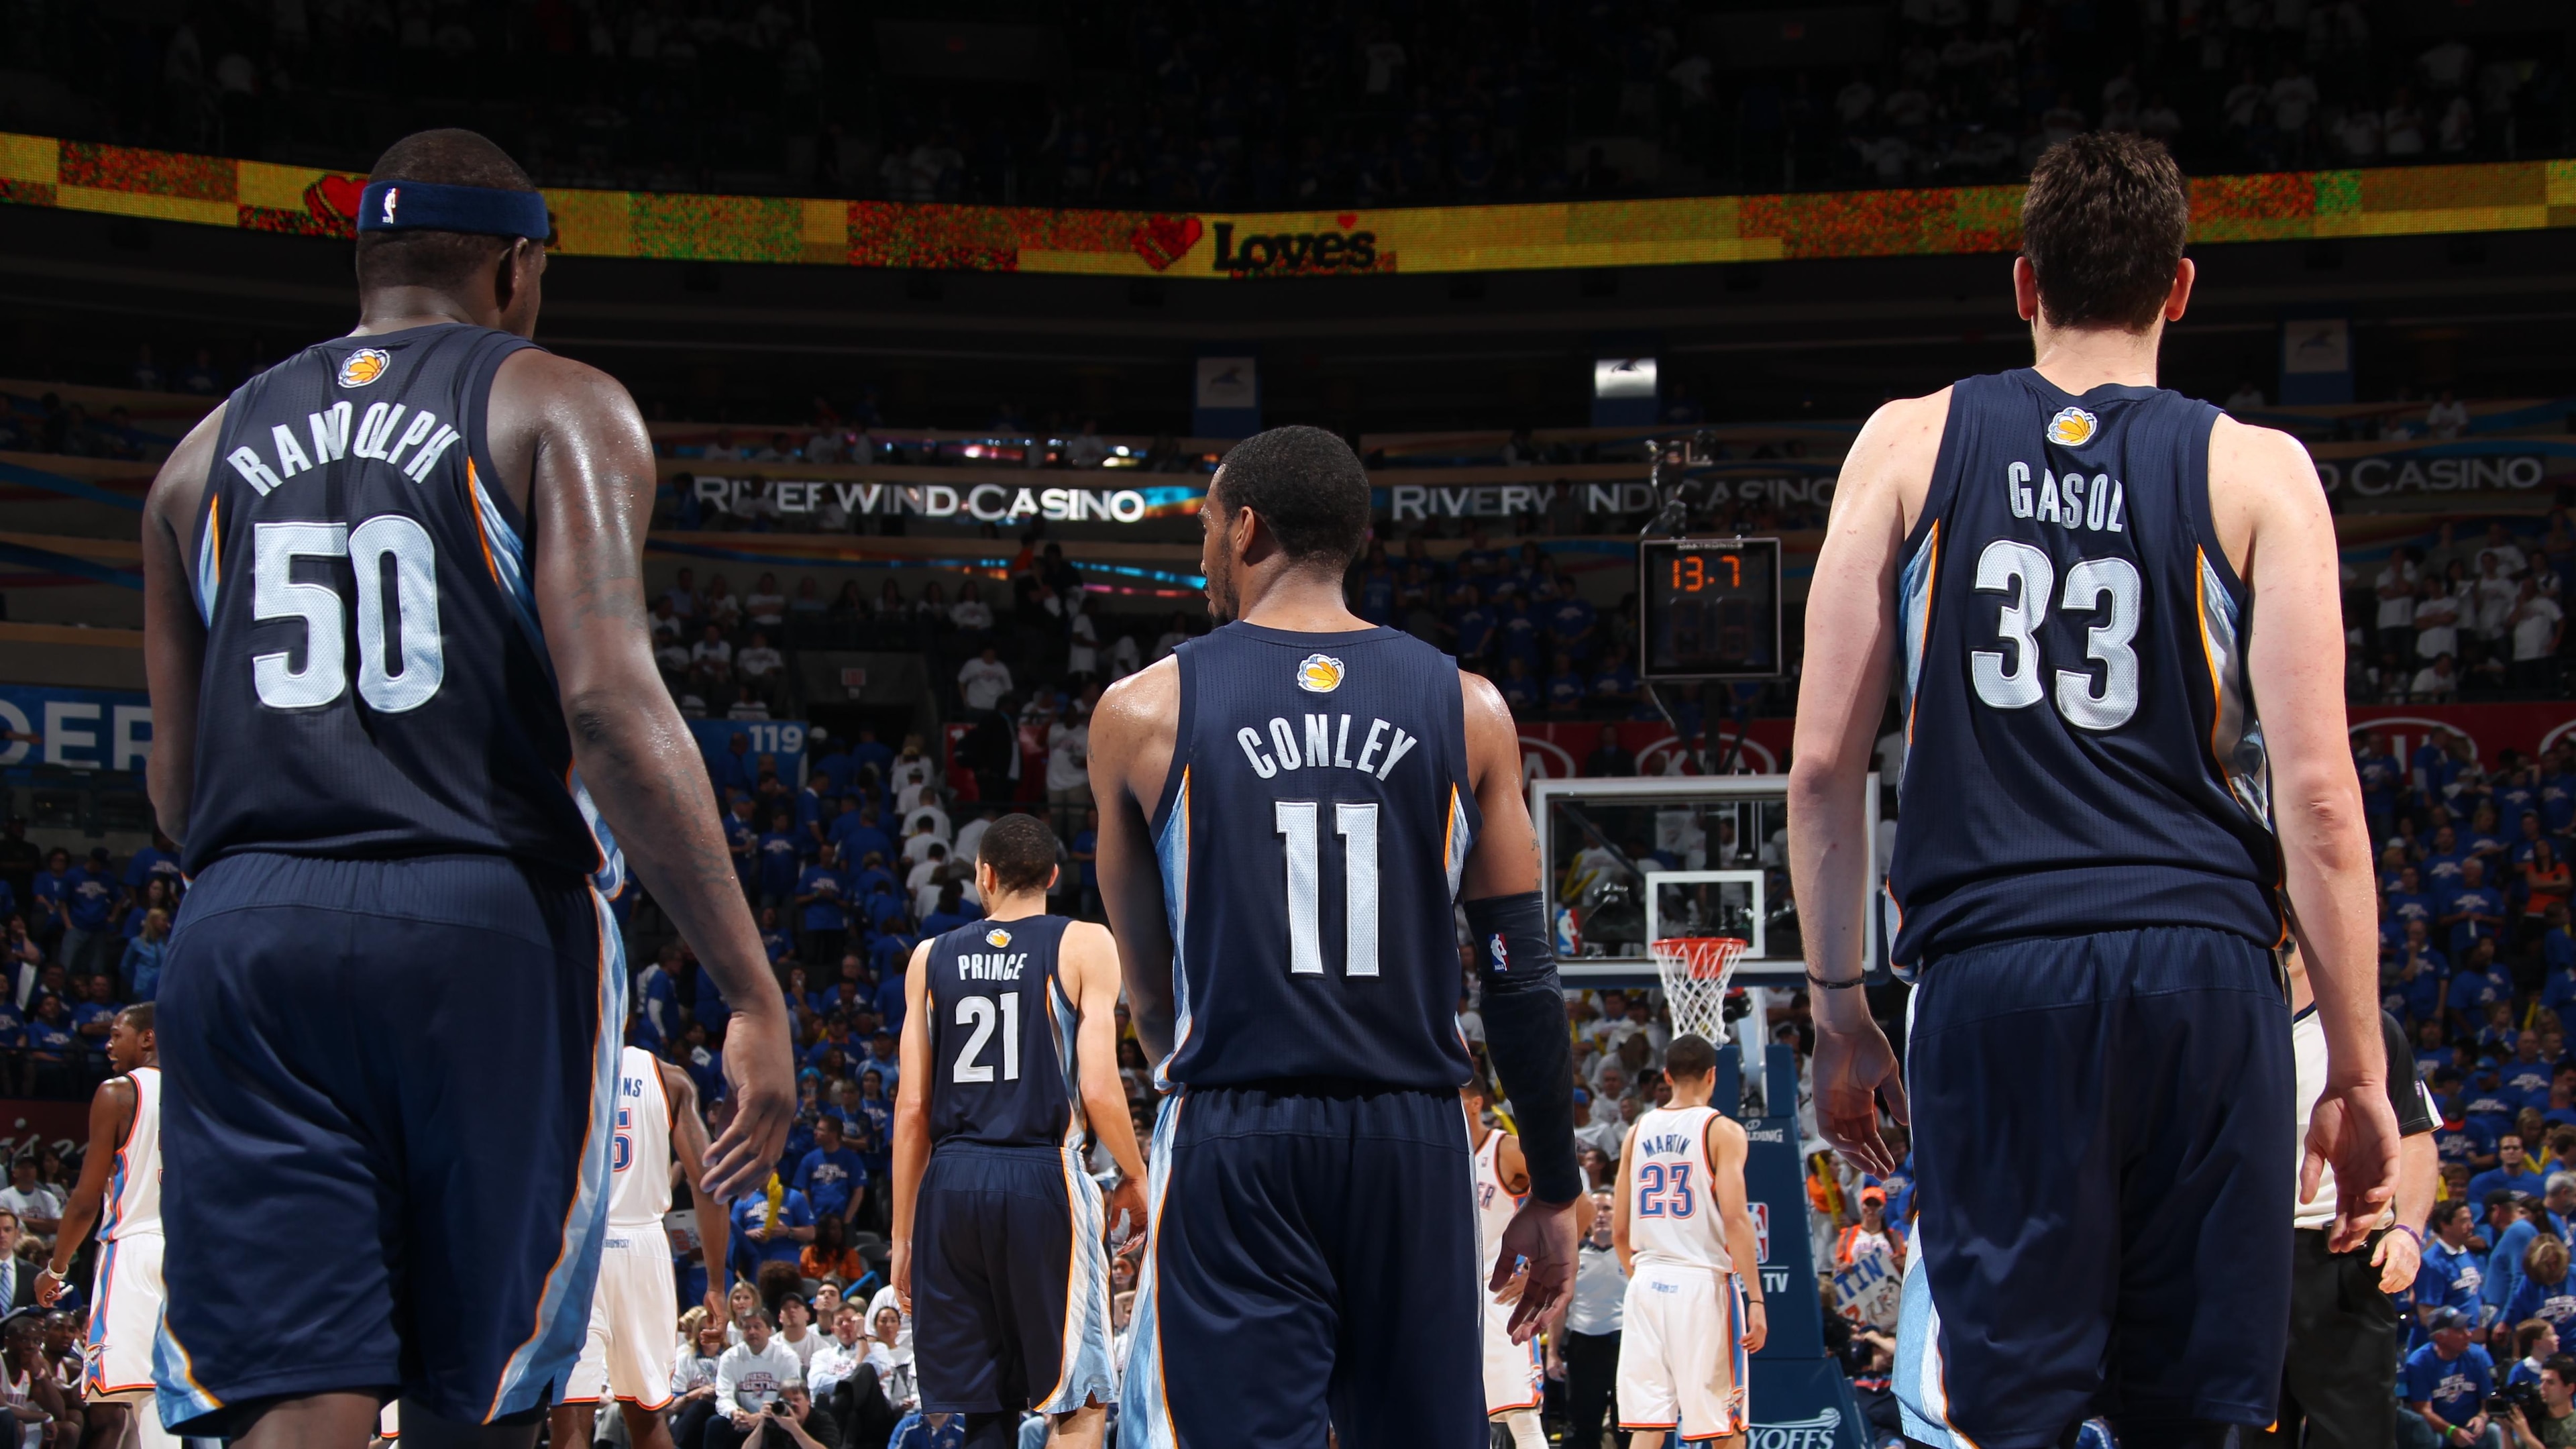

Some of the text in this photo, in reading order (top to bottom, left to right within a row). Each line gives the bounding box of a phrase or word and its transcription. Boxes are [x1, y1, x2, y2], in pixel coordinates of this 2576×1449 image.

[1214, 223, 1375, 270] Loves
[227, 400, 461, 497] RANDOLPH
[968, 483, 1145, 523] CASINO
[2008, 461, 2123, 533] GASOL
[2351, 458, 2543, 495] CASINO
[1672, 555, 1740, 592] 13.7
[252, 515, 444, 712] 50
[1971, 539, 2143, 731] 33
[749, 724, 804, 754] 119
[1236, 713, 1417, 782] CONLEY
[1275, 801, 1380, 977] 11
[957, 953, 1028, 981] PRINCE
[953, 991, 1019, 1084] 21
[1642, 1134, 1691, 1158] MARTIN
[1638, 1161, 1696, 1220] 23
[1763, 1273, 1789, 1293] TV
